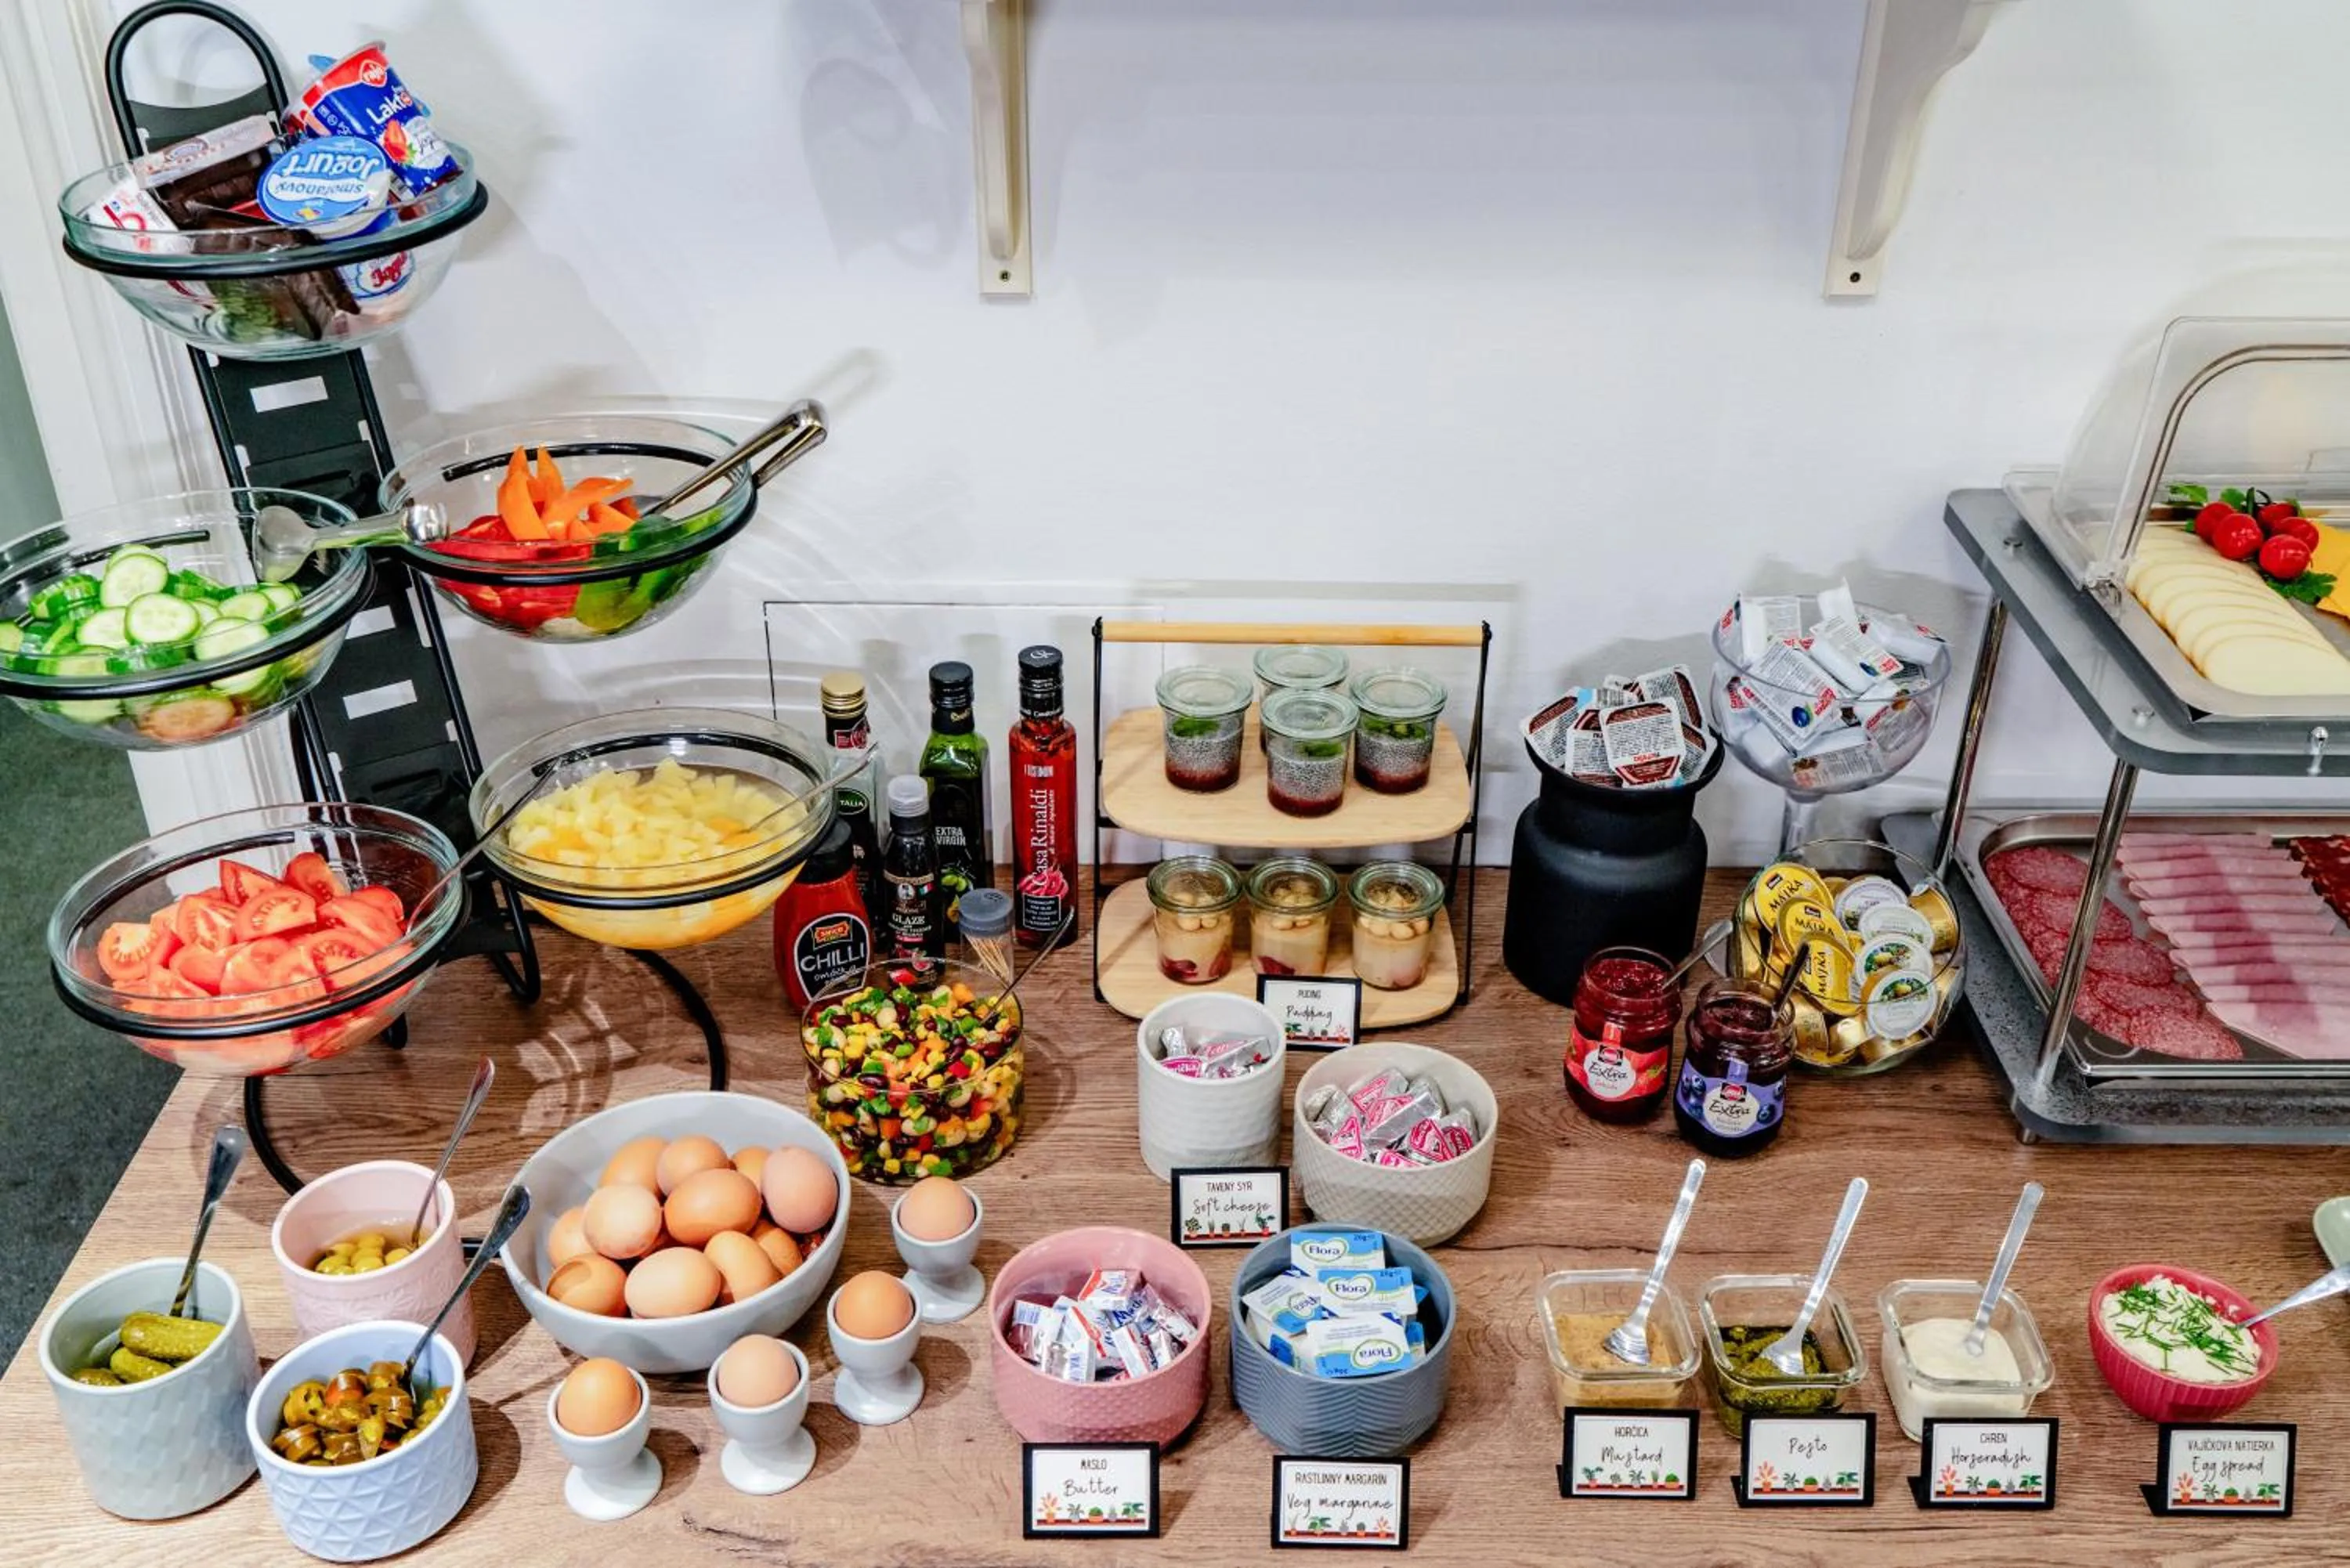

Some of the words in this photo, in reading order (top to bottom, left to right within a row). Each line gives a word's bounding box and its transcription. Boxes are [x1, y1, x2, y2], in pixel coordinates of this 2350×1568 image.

[281, 153, 380, 180] Jogurt
[1029, 789, 1047, 847] Rinaldi
[935, 826, 964, 837] EXTRA
[935, 836, 966, 847] VIRGIN
[892, 912, 925, 925] GLAZE
[800, 942, 865, 972] CHILLI
[1589, 1060, 1629, 1082] Extra
[1708, 1099, 1750, 1119] Extra
[1192, 1196, 1220, 1217] Soft
[1223, 1196, 1271, 1216] cheese
[1309, 1245, 1340, 1255] Flora
[1335, 1283, 1368, 1293] Flora
[1359, 1346, 1393, 1358] Flora
[1601, 1445, 1663, 1469] Mustard
[1788, 1434, 1828, 1459] Pesto
[1950, 1445, 2032, 1469] Horseradish
[2192, 1456, 2217, 1483] Egg
[2219, 1455, 2265, 1480] spread
[1064, 1476, 1120, 1497] Butter
[1287, 1494, 1312, 1519] Veg
[1318, 1496, 1394, 1520] margarine
